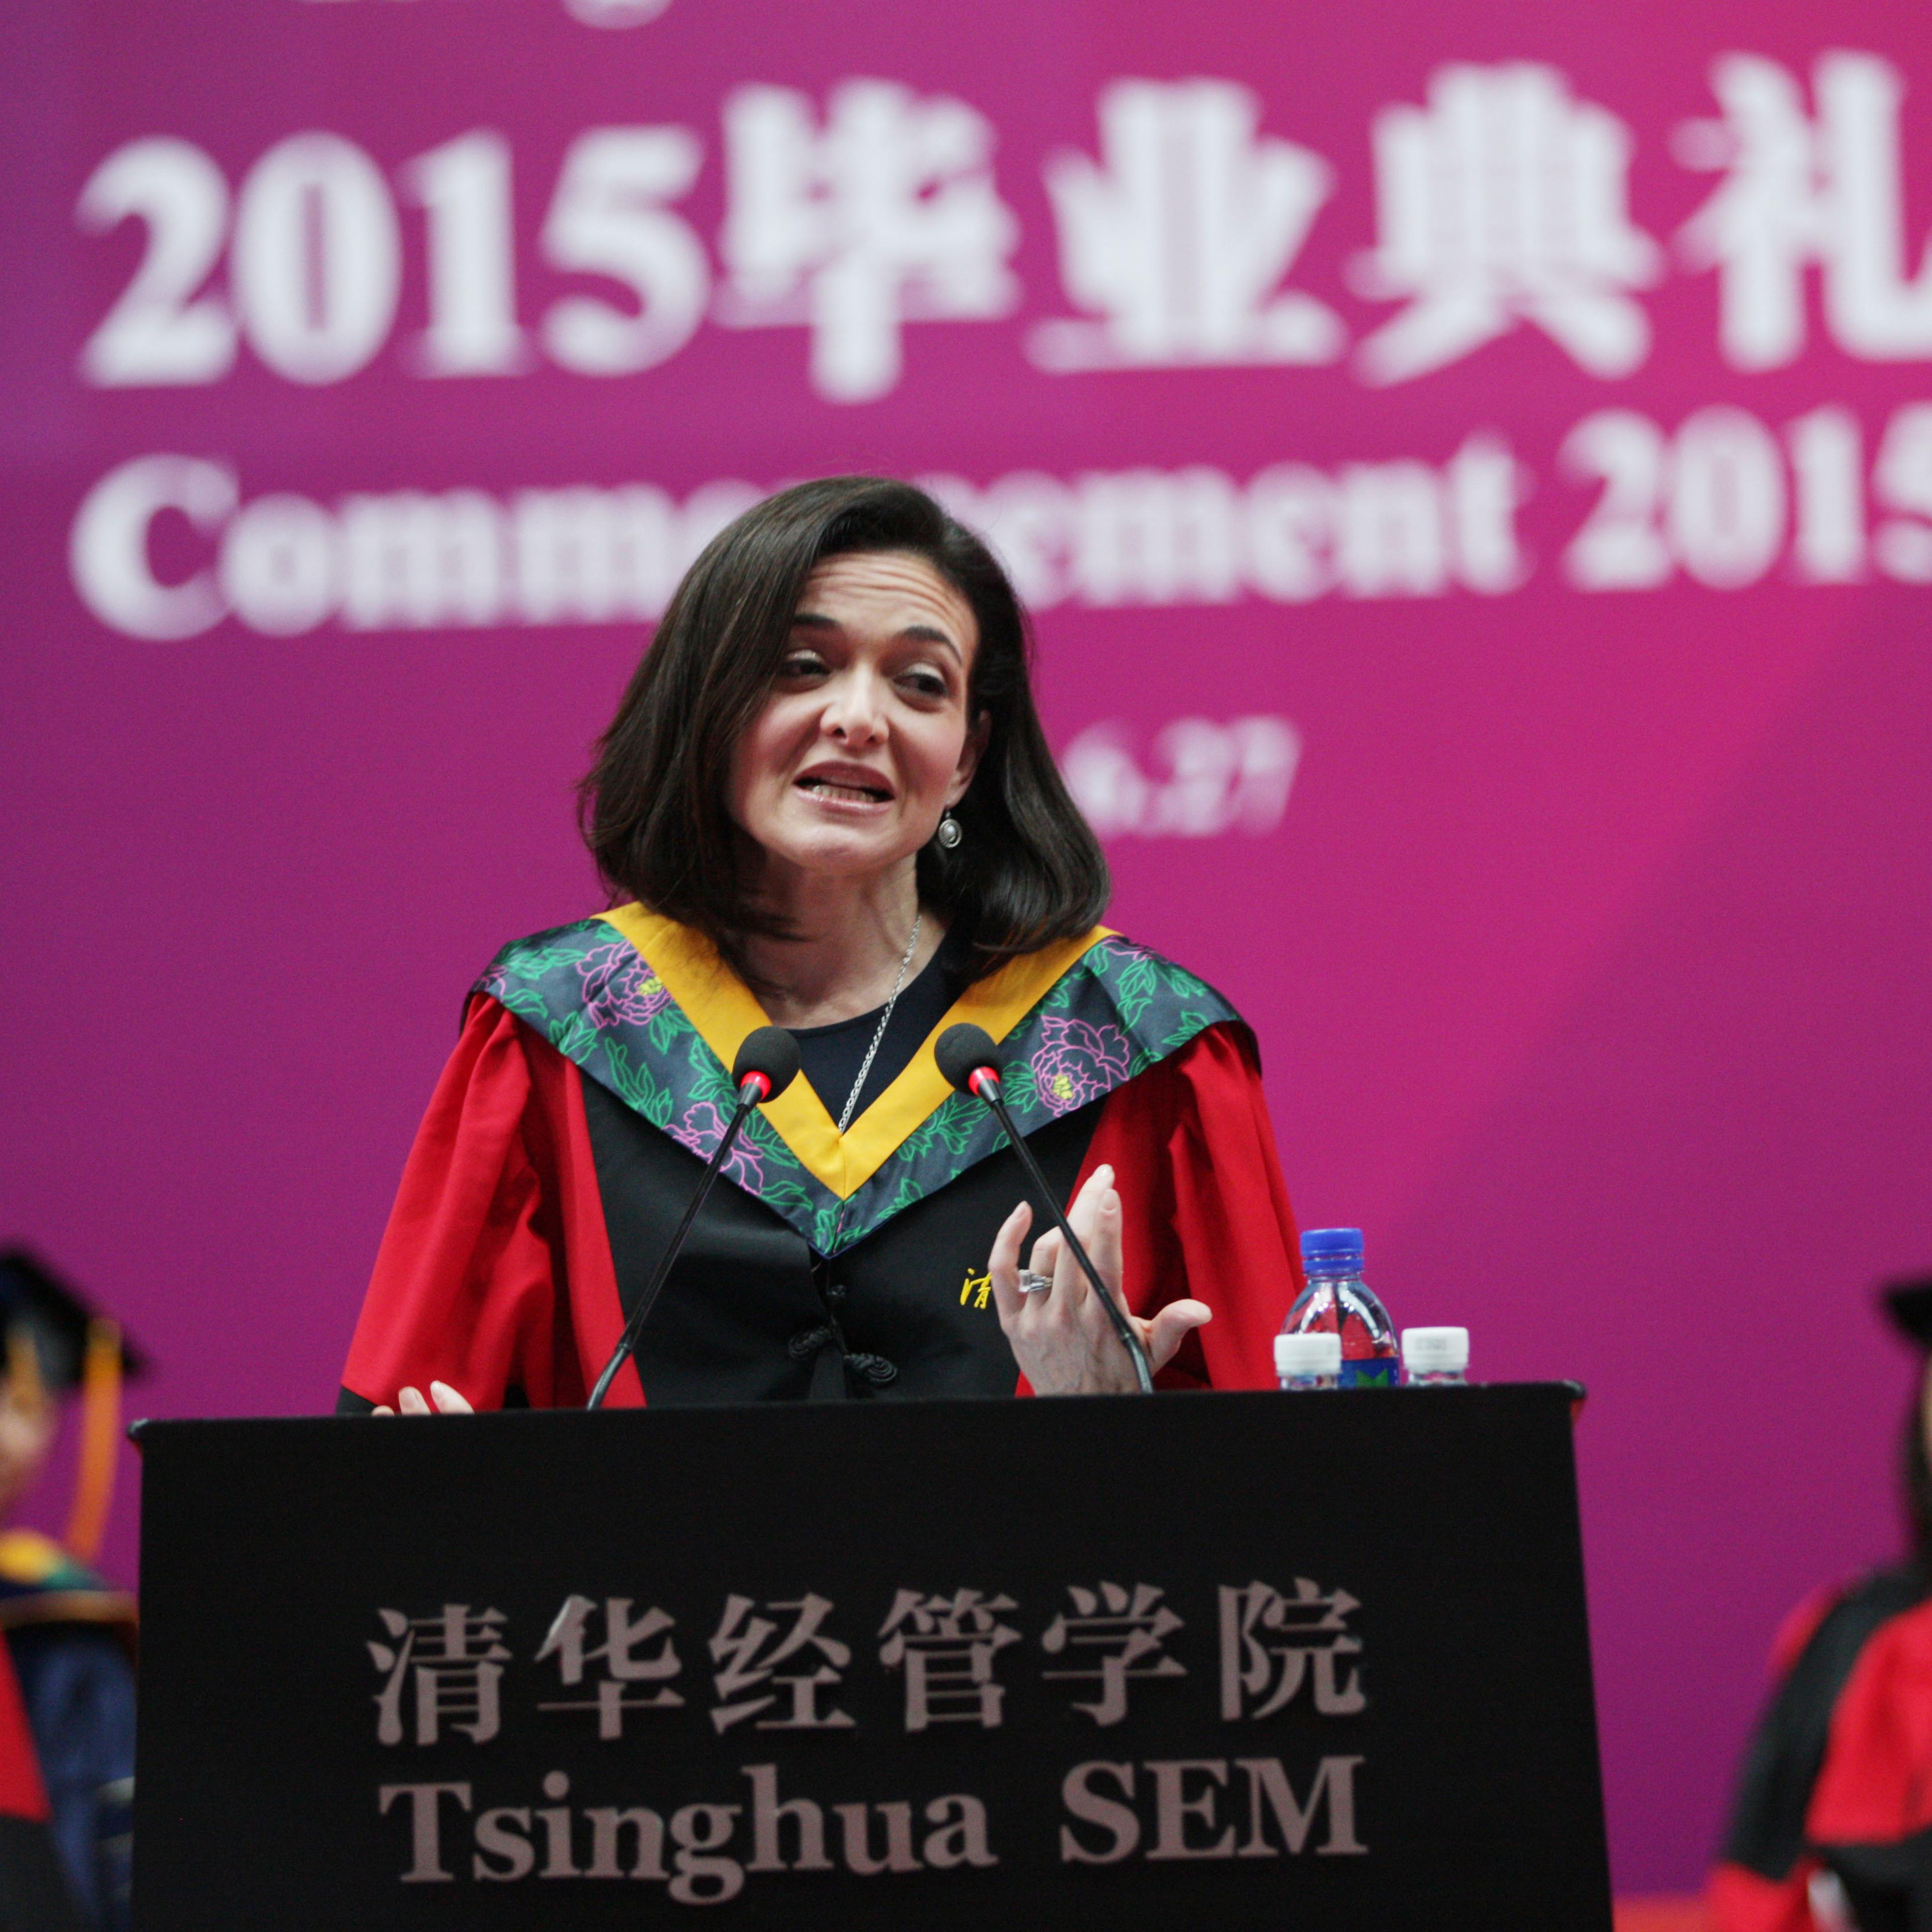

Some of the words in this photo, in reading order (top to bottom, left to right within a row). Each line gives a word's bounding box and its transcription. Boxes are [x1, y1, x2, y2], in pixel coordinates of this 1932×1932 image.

[69, 433, 1531, 640] Commement
[367, 1577, 1366, 1745] 清华经管学院
[379, 1763, 998, 1904] Tsinghua
[1060, 1755, 1369, 1864] SEM
